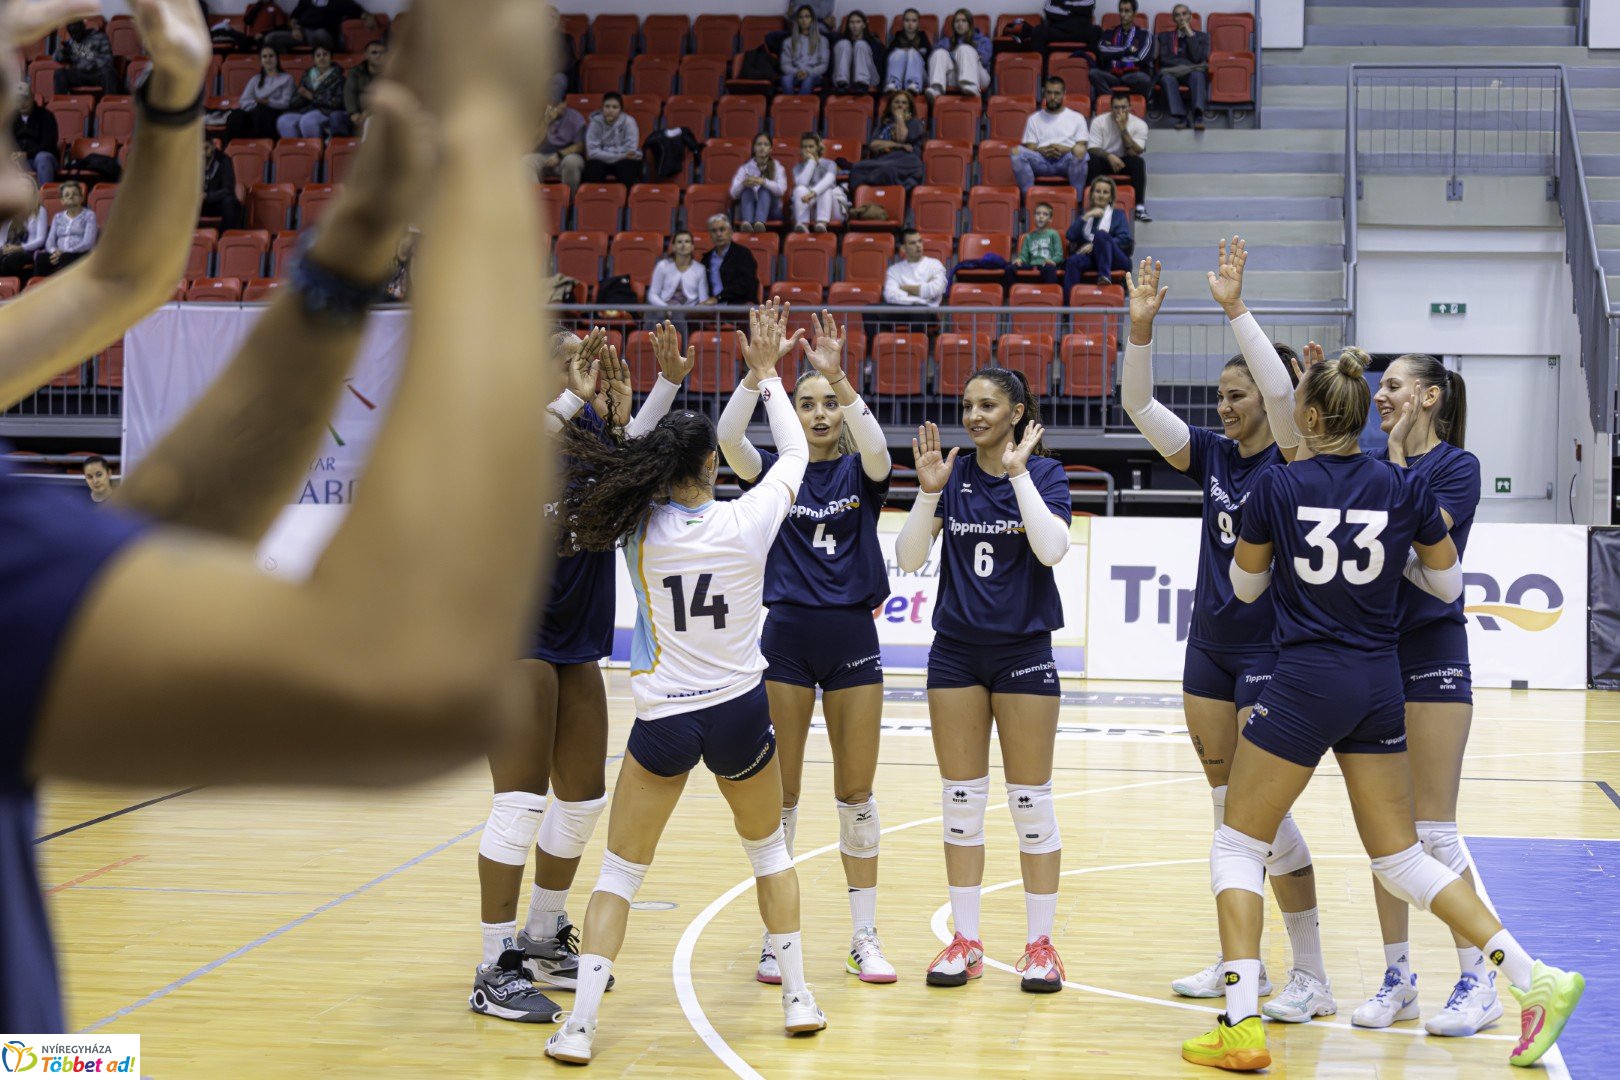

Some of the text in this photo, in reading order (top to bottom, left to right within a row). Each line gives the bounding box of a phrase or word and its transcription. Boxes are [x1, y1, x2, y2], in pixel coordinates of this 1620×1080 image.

[812, 523, 837, 555] 4
[1217, 511, 1237, 544] 9
[973, 541, 994, 578] 6
[1293, 505, 1388, 585] 33
[662, 573, 729, 632] 14
[873, 591, 928, 624] et
[1245, 673, 1275, 683] Tippm
